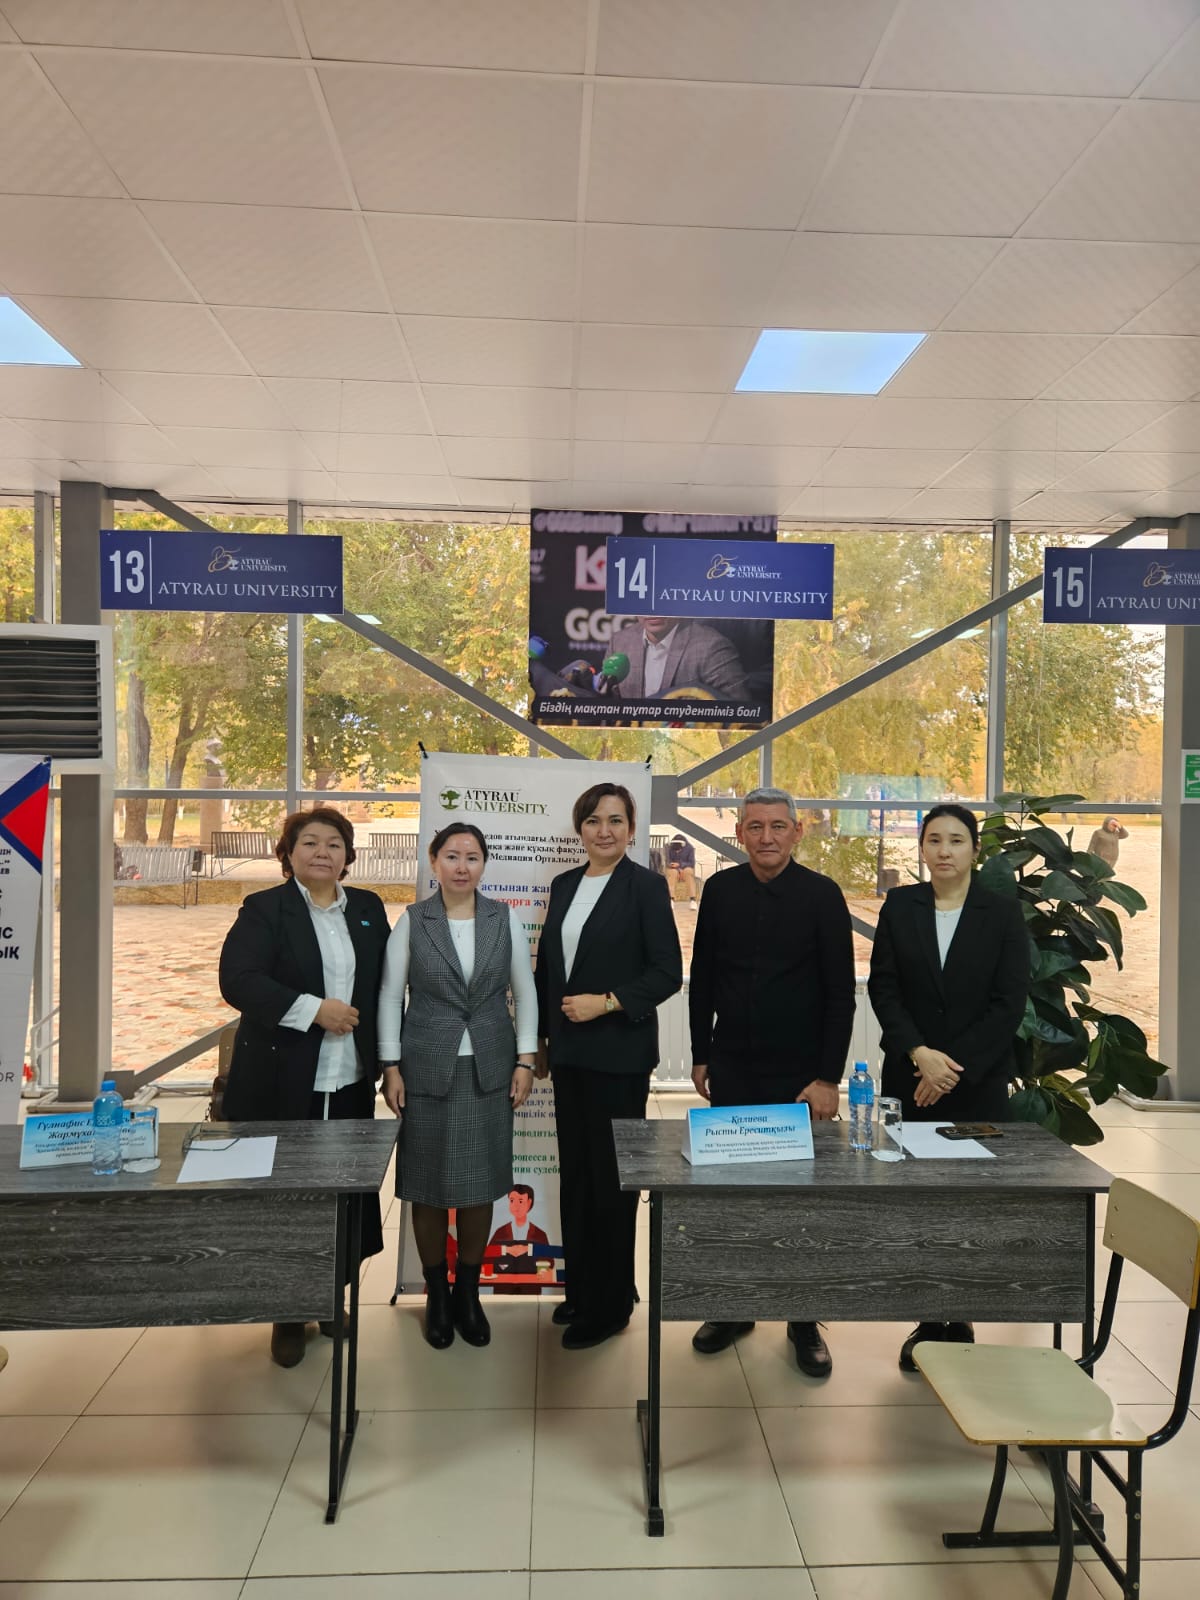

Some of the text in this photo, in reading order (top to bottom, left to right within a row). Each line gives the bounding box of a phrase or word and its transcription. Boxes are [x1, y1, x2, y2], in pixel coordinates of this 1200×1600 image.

[240, 558, 272, 566] ATYRAU
[240, 564, 287, 573] UNIVERSITY
[109, 550, 145, 593] 13
[737, 565, 766, 573] ATYRAU
[737, 571, 781, 579] UNIVERSITY
[614, 557, 648, 599] 14
[158, 581, 338, 598] ATYRAU UNIVERSITY
[1052, 566, 1084, 608] 15
[660, 588, 829, 605] ATYRAU UNIVERSITY
[1096, 596, 1200, 610] ATYRAU UNI
[539, 701, 761, 718] Біздің мақтан тұтар студентіміз бол!
[464, 789, 519, 802] ATYRAU
[463, 801, 548, 815] UNIVERSITY
[548, 835, 581, 845] Атырау
[490, 853, 580, 865] Медиация Орталығы
[481, 884, 528, 893] астынан
